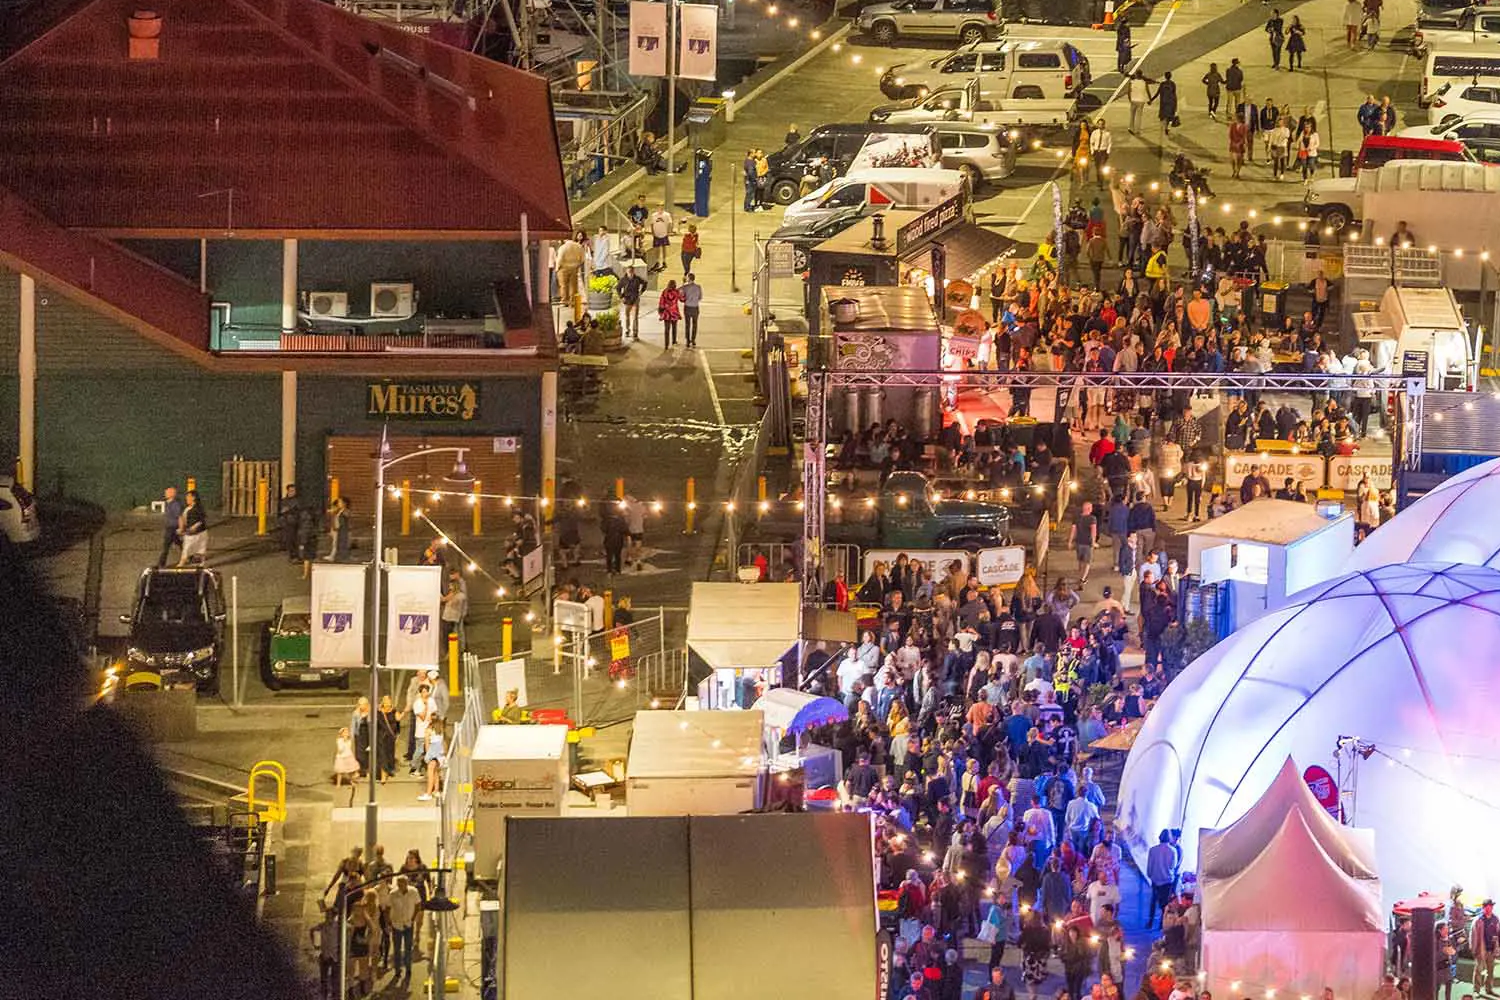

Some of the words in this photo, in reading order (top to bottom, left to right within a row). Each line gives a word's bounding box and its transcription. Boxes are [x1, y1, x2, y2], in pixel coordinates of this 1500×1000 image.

[402, 384, 457, 394] TASMANIA
[368, 385, 459, 415] Mures
[1233, 462, 1294, 476] CACADE
[982, 561, 1020, 574] CASCADE
